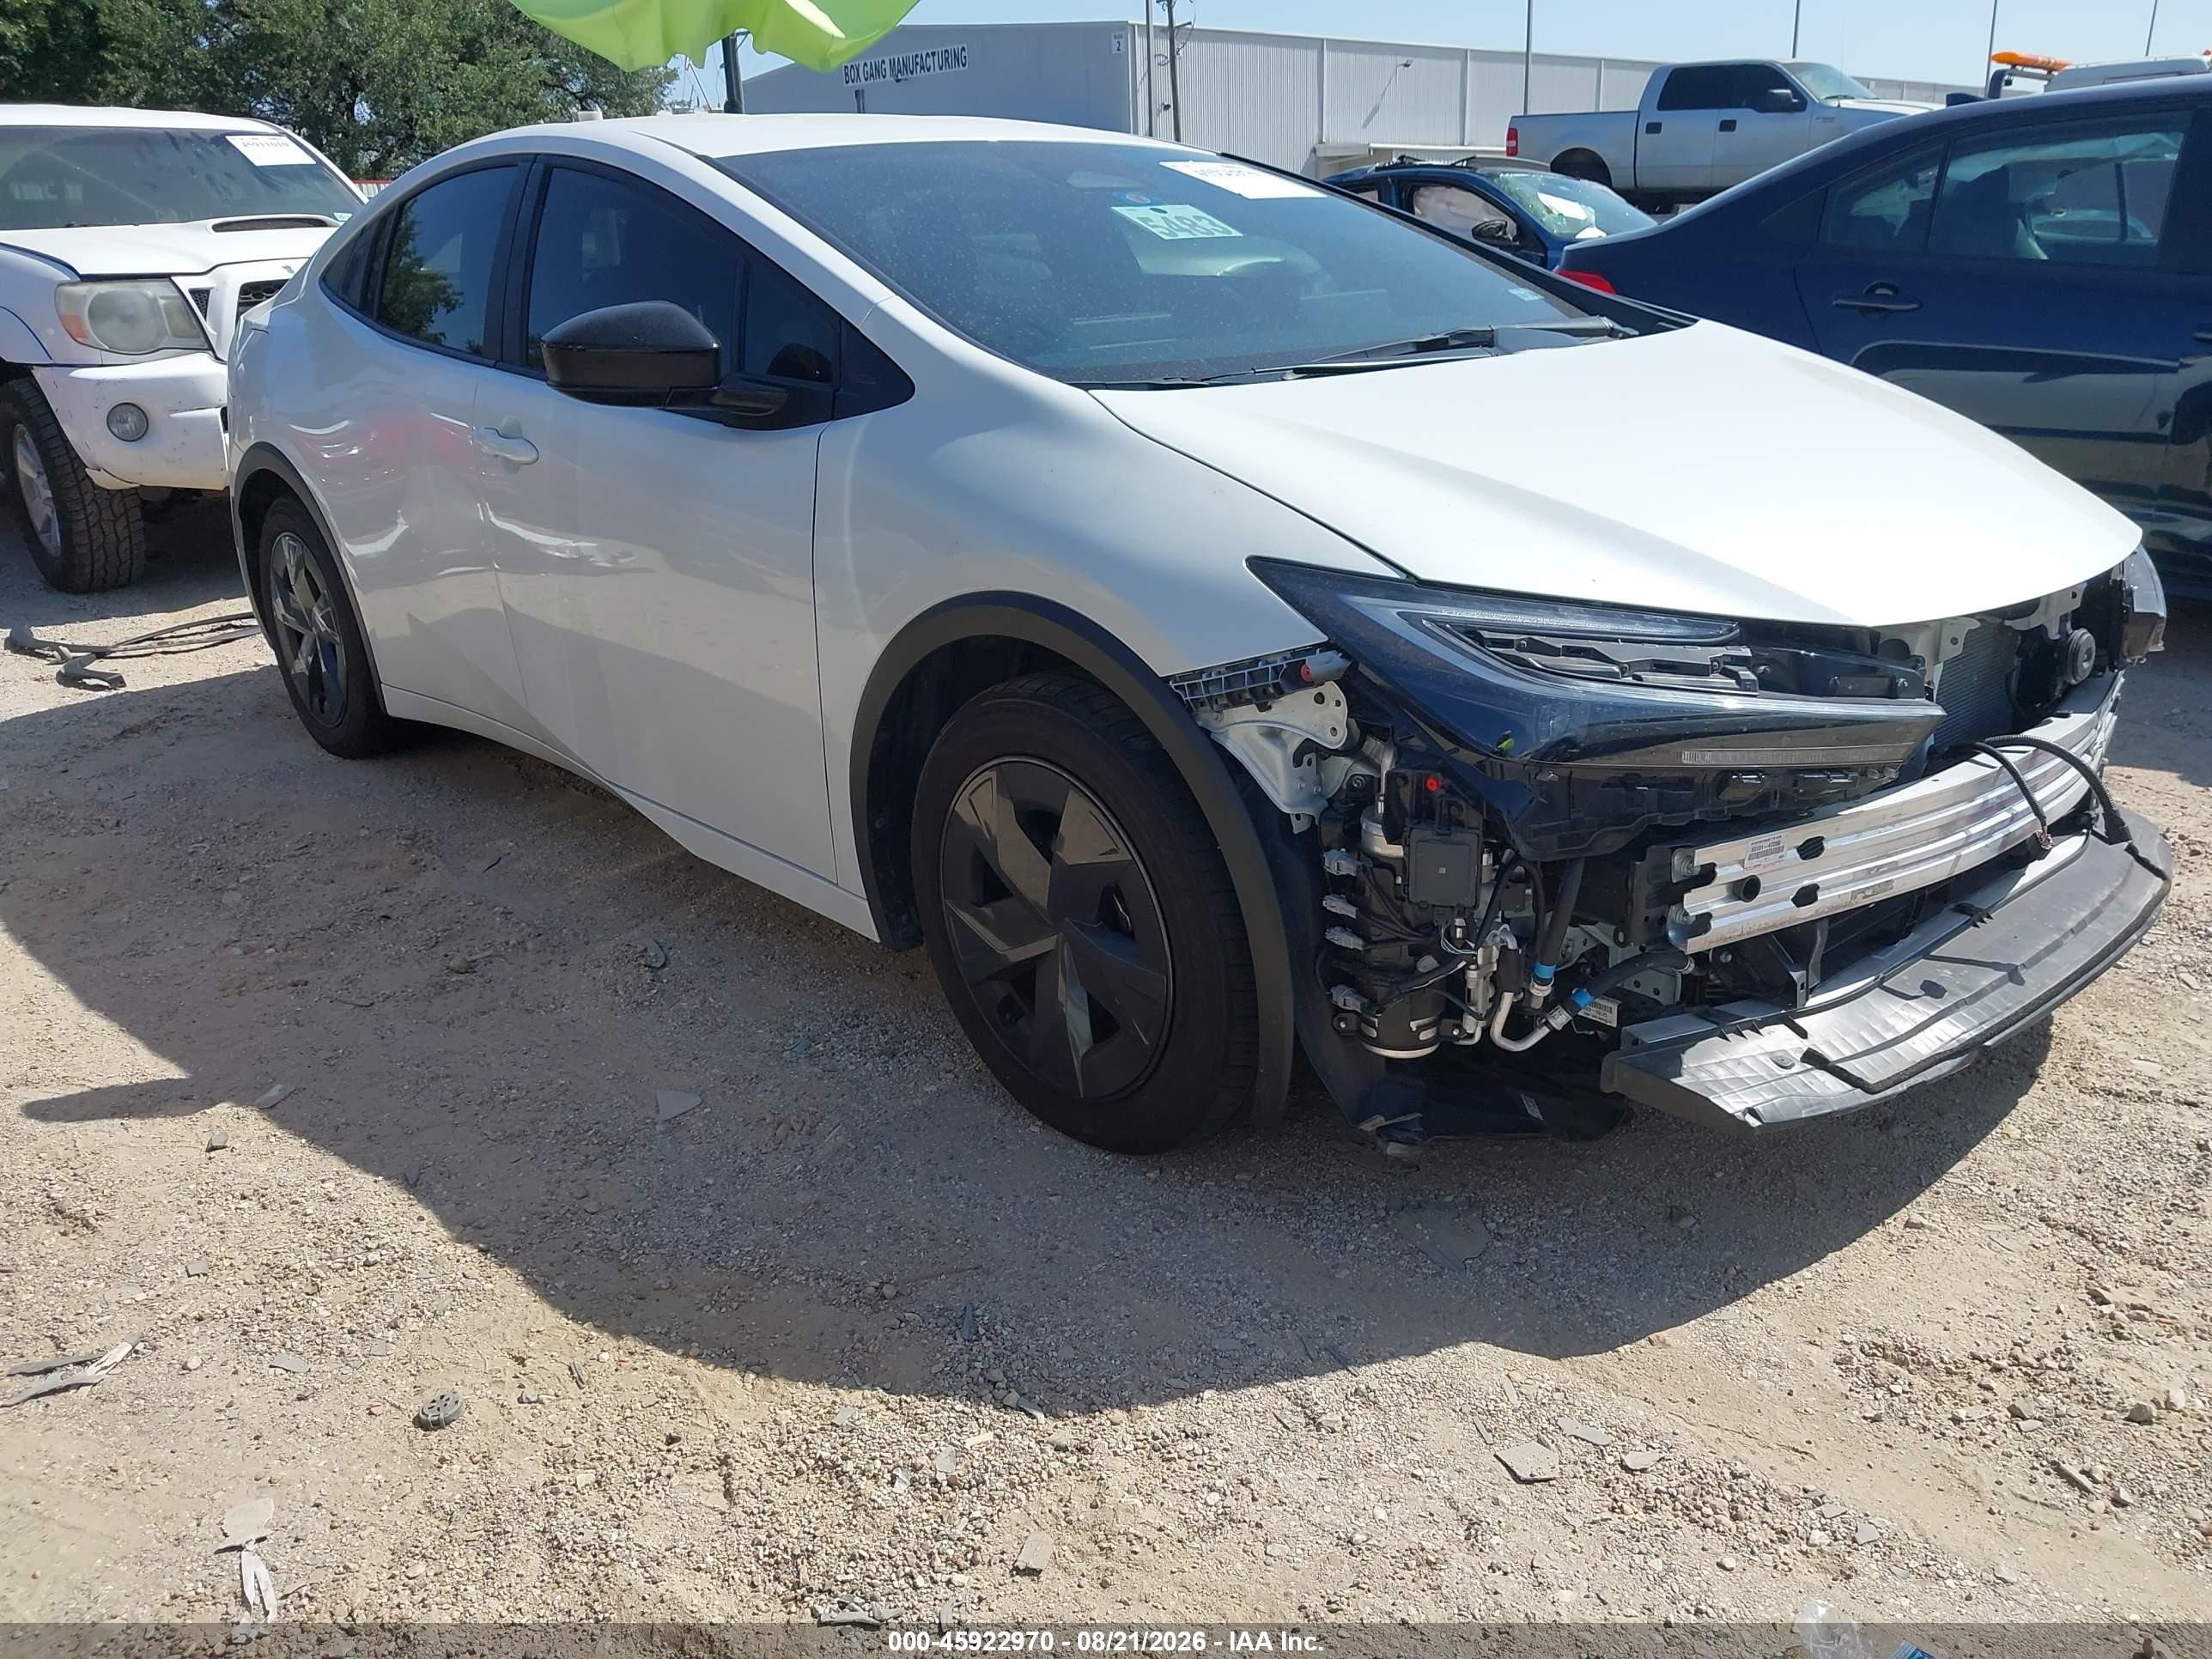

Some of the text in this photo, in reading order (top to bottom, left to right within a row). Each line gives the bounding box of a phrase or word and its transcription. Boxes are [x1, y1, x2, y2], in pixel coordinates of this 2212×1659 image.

[1116, 40, 1121, 52] 2
[844, 46, 968, 84] BOX GANG MANUFACTURING
[1137, 215, 1233, 238] 5483
